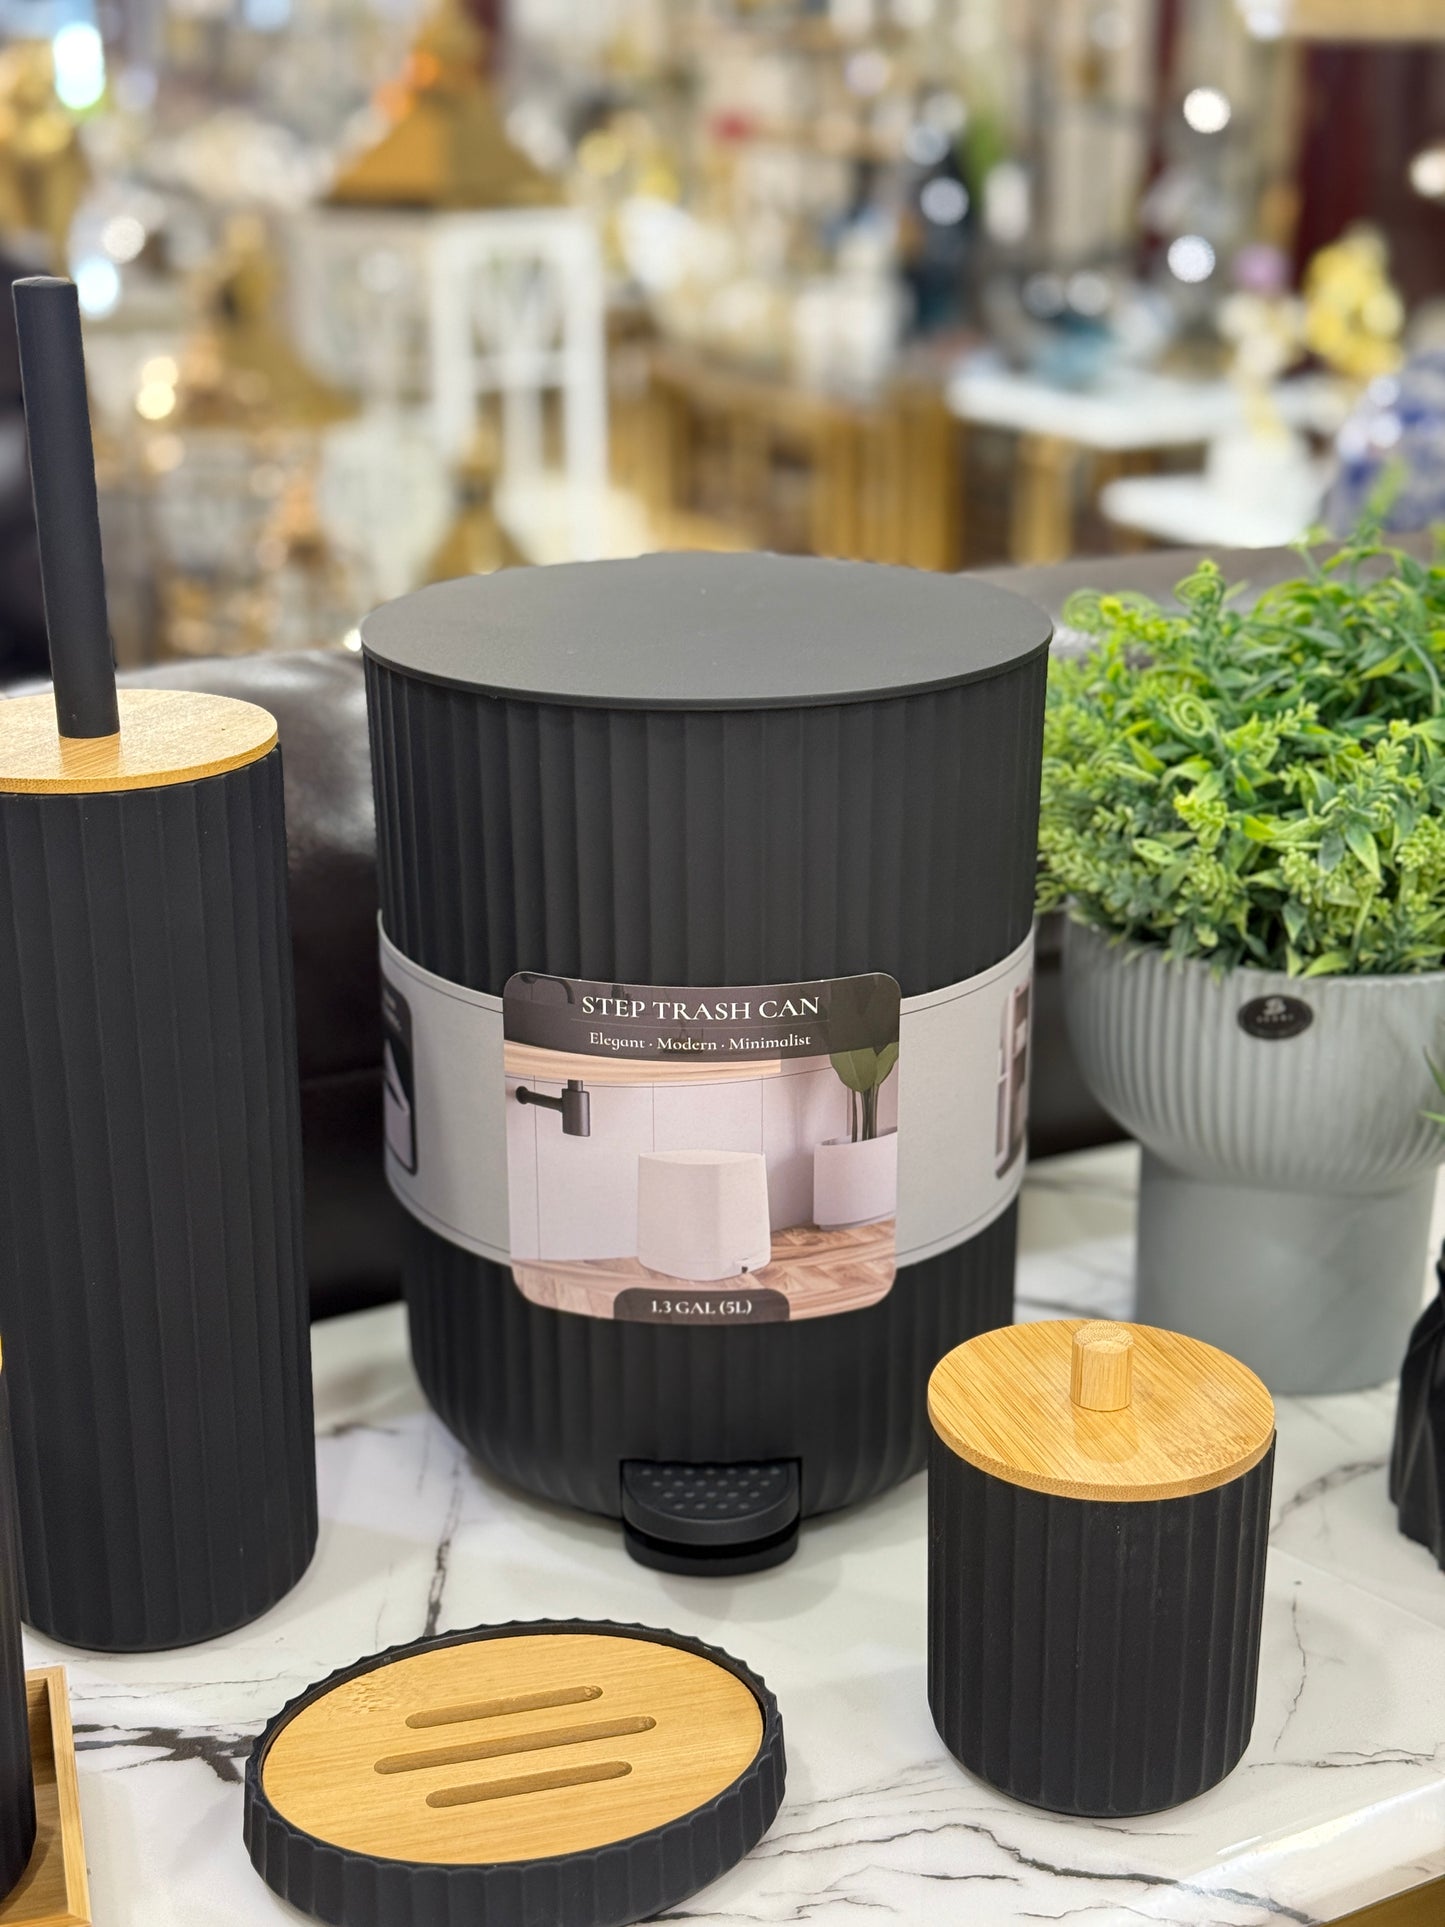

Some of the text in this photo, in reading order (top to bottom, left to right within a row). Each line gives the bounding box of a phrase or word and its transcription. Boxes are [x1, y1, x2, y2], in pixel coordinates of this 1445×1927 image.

[582, 996, 819, 1020] STEP TRASH CAN
[589, 1032, 811, 1050] Elegant Modern Minimalist
[651, 1300, 752, 1315] 1.3 GAL (5L)
